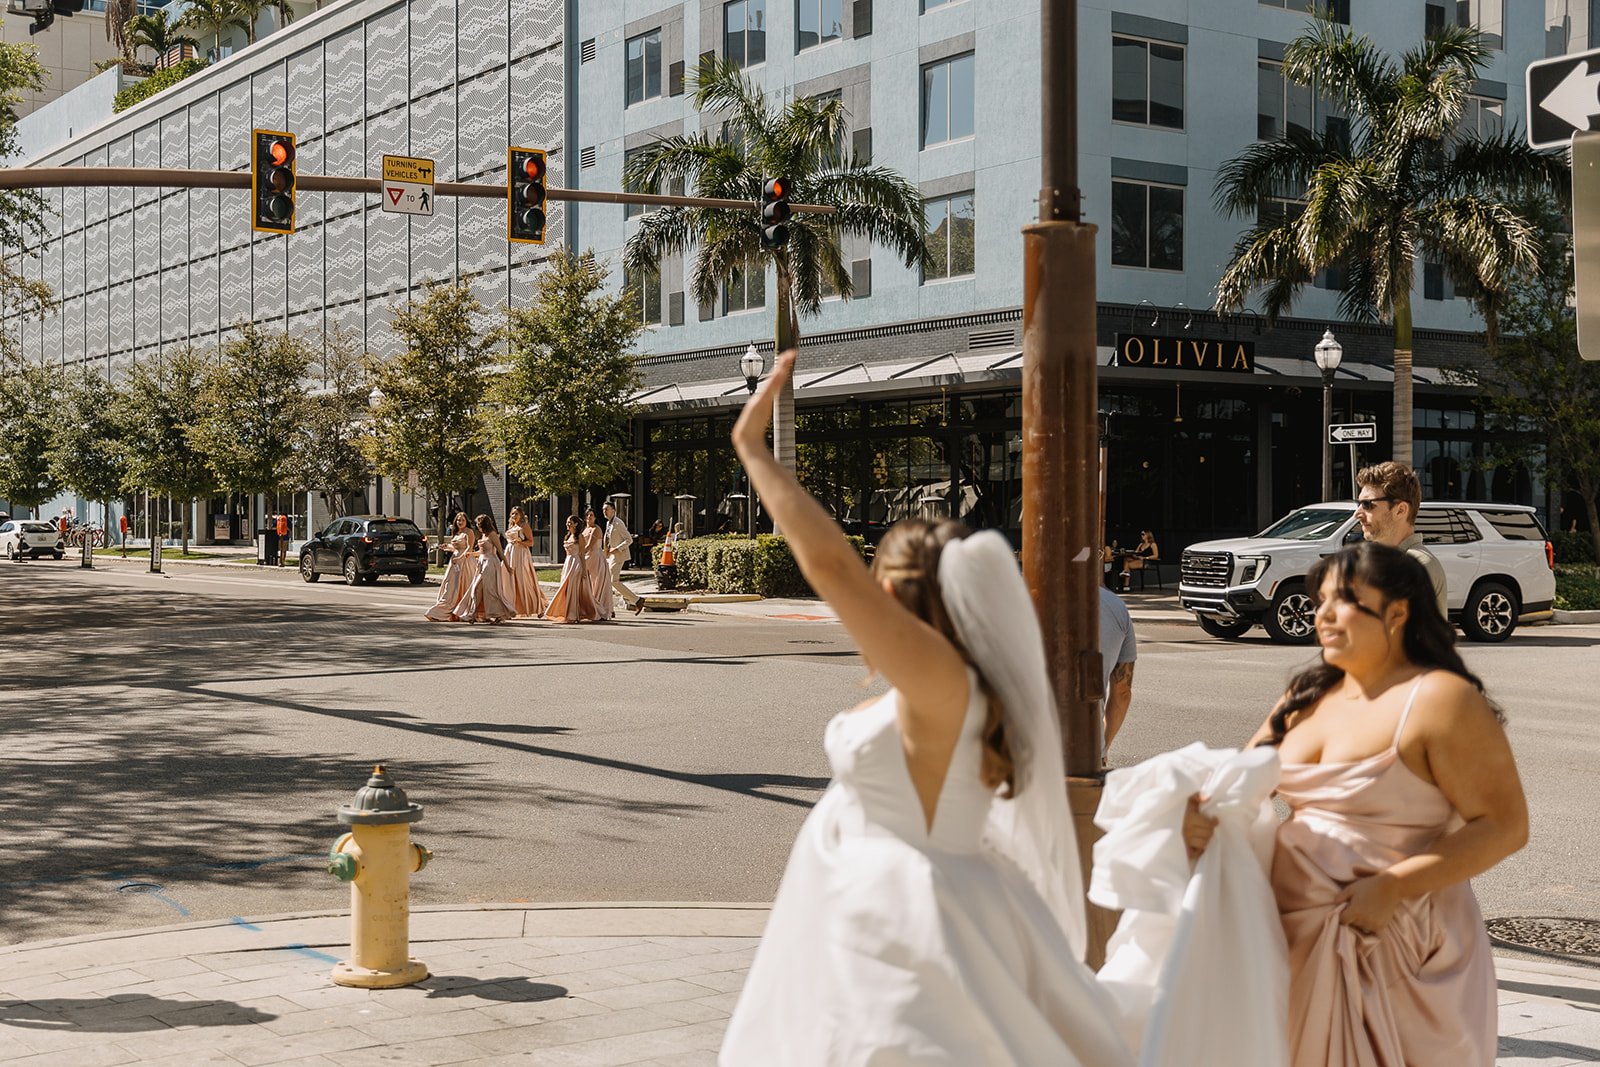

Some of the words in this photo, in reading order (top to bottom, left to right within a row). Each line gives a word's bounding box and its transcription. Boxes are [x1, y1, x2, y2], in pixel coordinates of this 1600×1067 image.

[387, 160, 417, 169] TURNING
[386, 170, 418, 179] VEHICLES
[1125, 337, 1248, 369] OLIVIA
